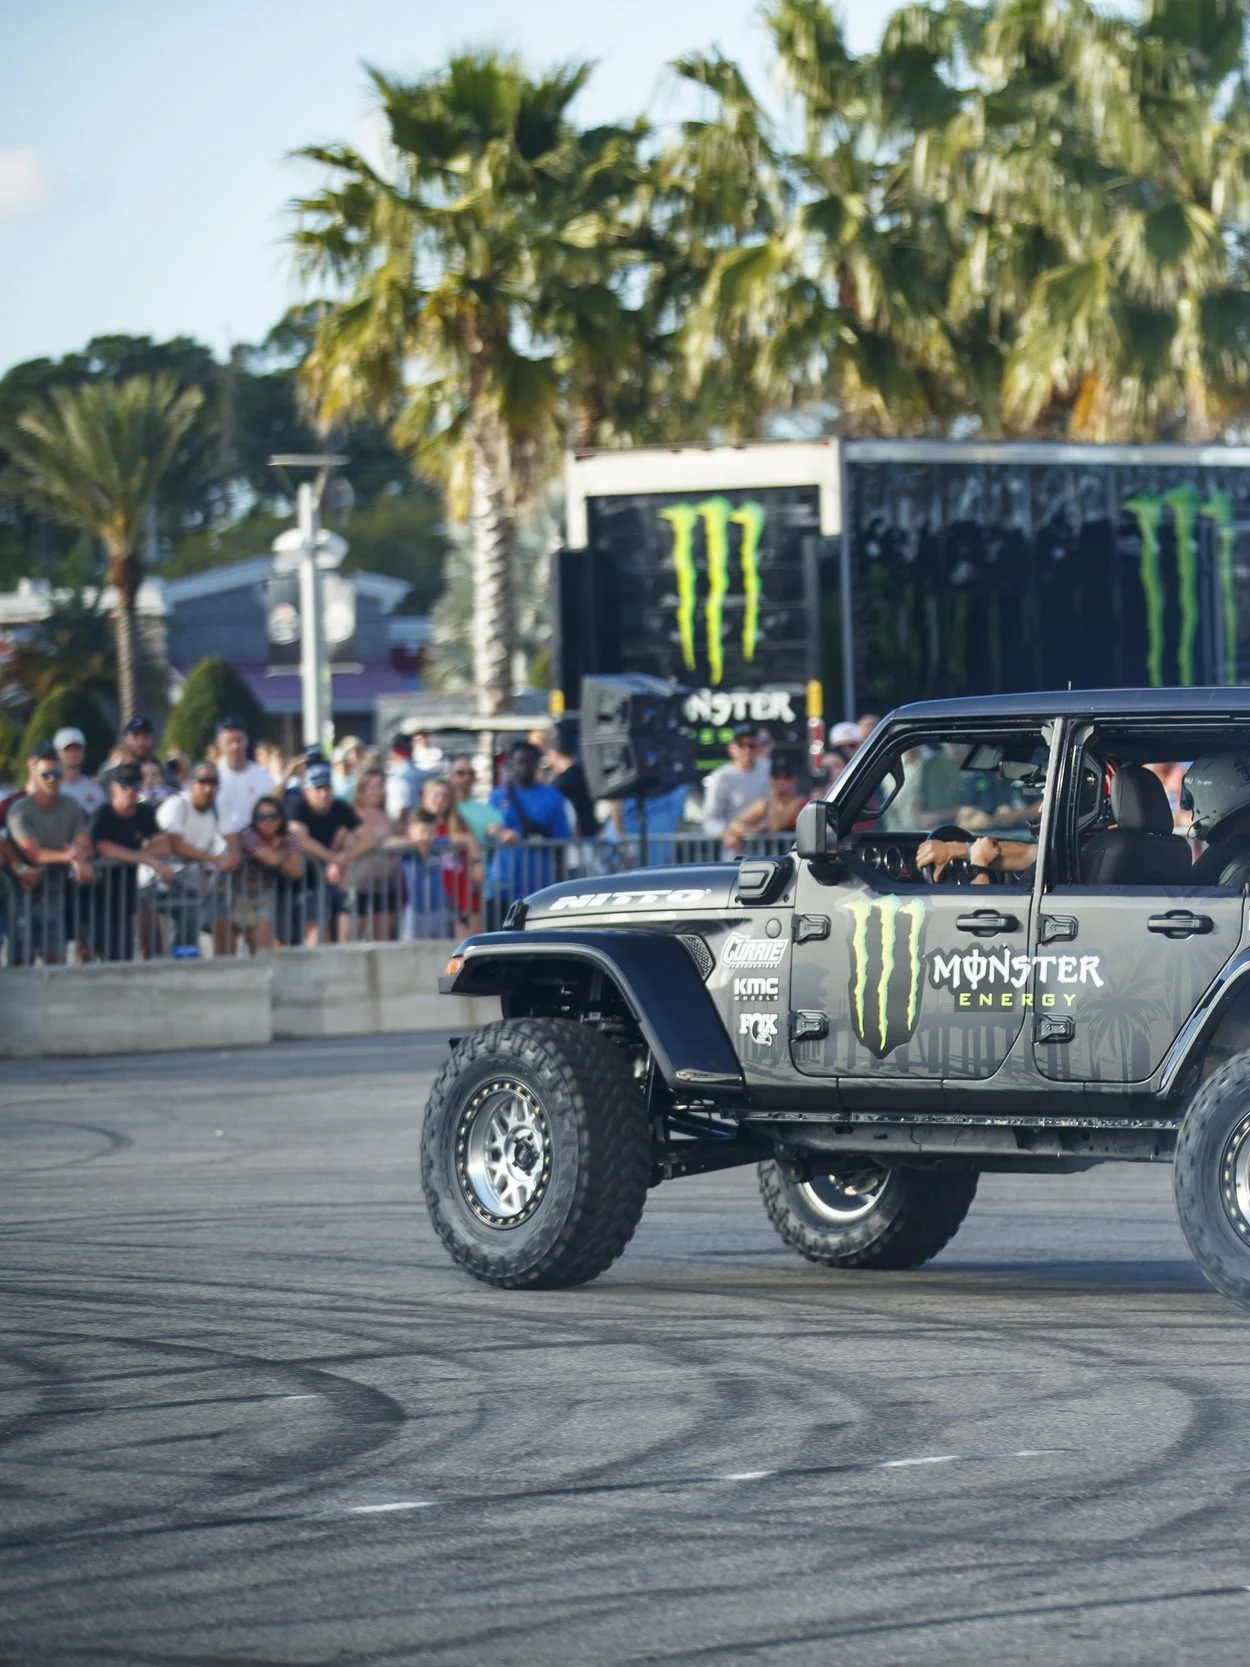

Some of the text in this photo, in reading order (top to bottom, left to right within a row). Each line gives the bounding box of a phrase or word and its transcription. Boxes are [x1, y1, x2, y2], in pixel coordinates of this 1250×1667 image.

[550, 889, 708, 910] NITTO
[933, 949, 1105, 990] MONSTER
[734, 978, 779, 995] KMC
[959, 993, 1076, 1007] ENERGY
[739, 1012, 778, 1045] FOX
